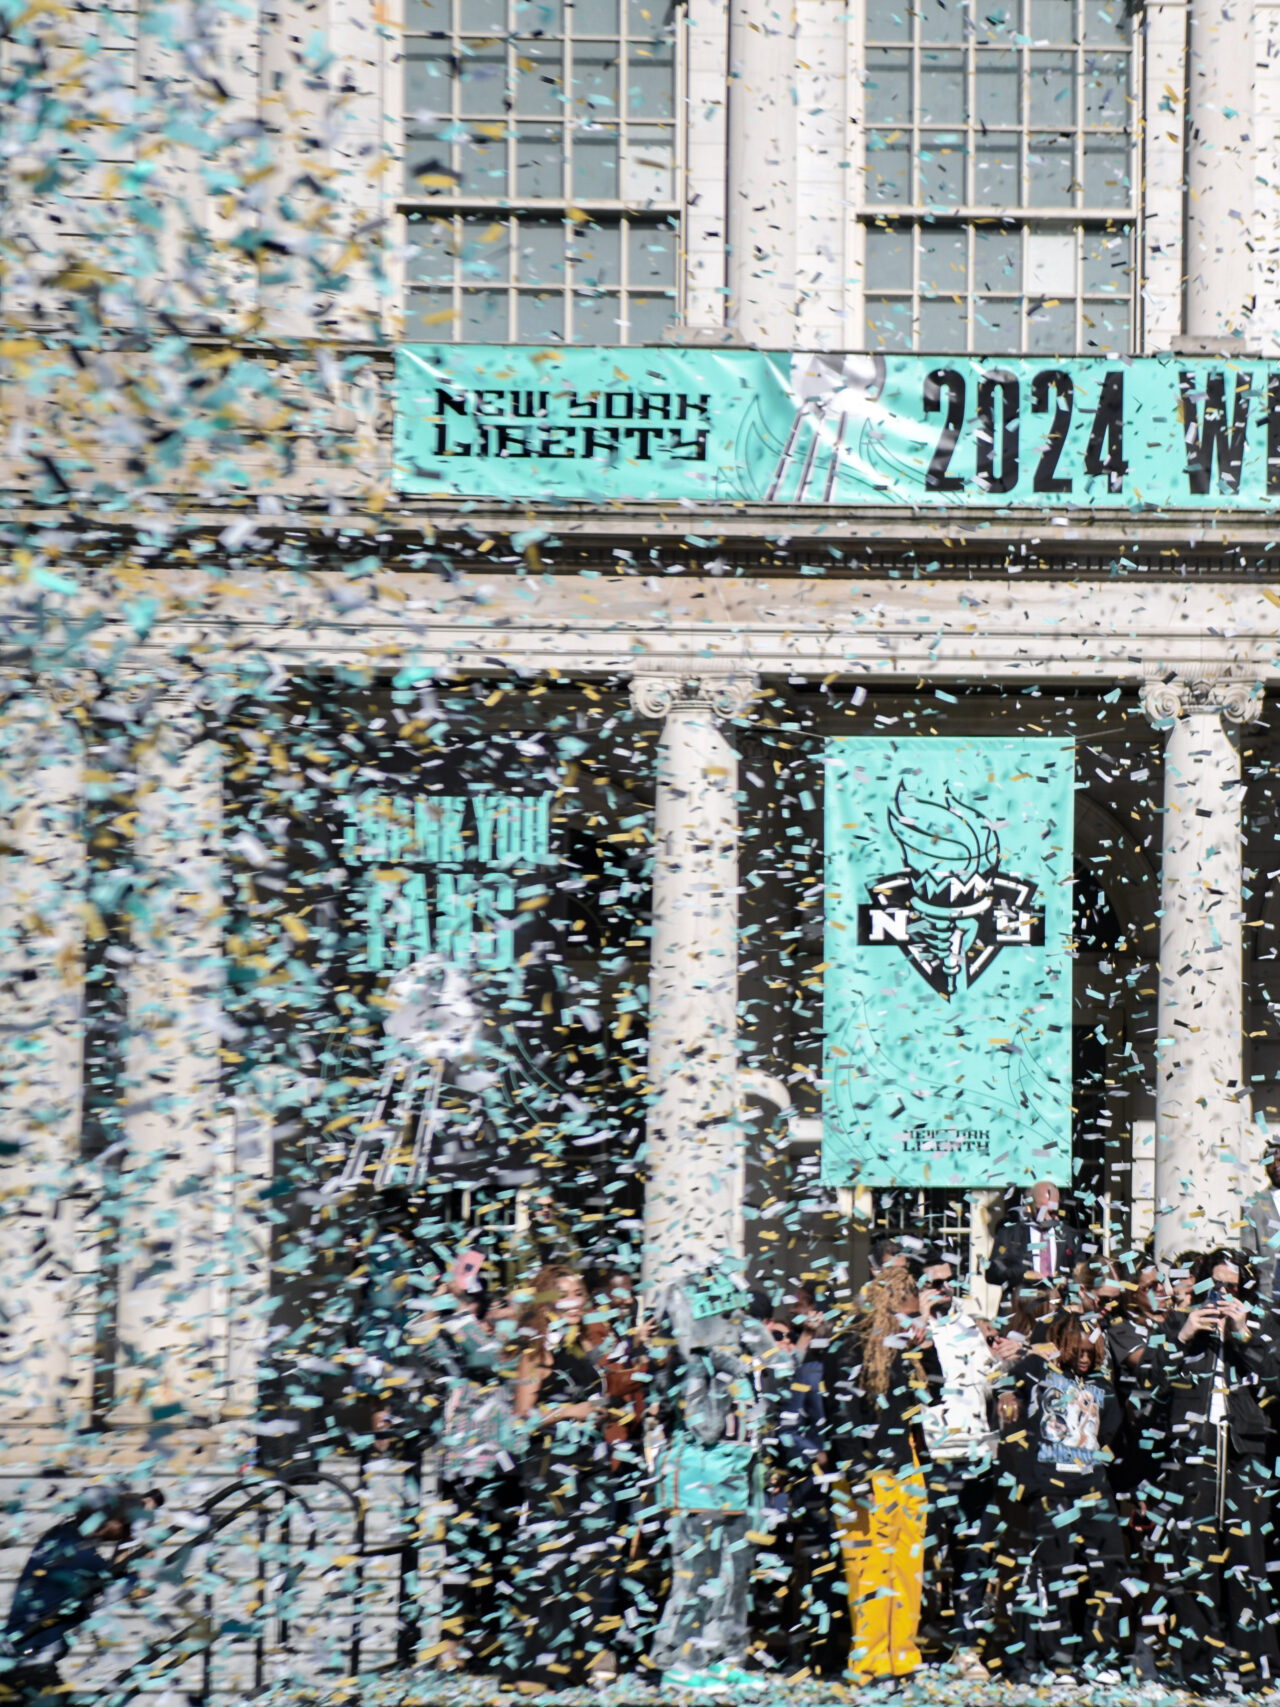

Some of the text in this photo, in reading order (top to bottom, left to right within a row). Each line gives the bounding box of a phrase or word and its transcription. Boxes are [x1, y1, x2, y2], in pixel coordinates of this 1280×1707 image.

[433, 388, 711, 420] NEW YORK
[432, 424, 711, 461] LIBERTY
[923, 369, 1129, 494] 2024
